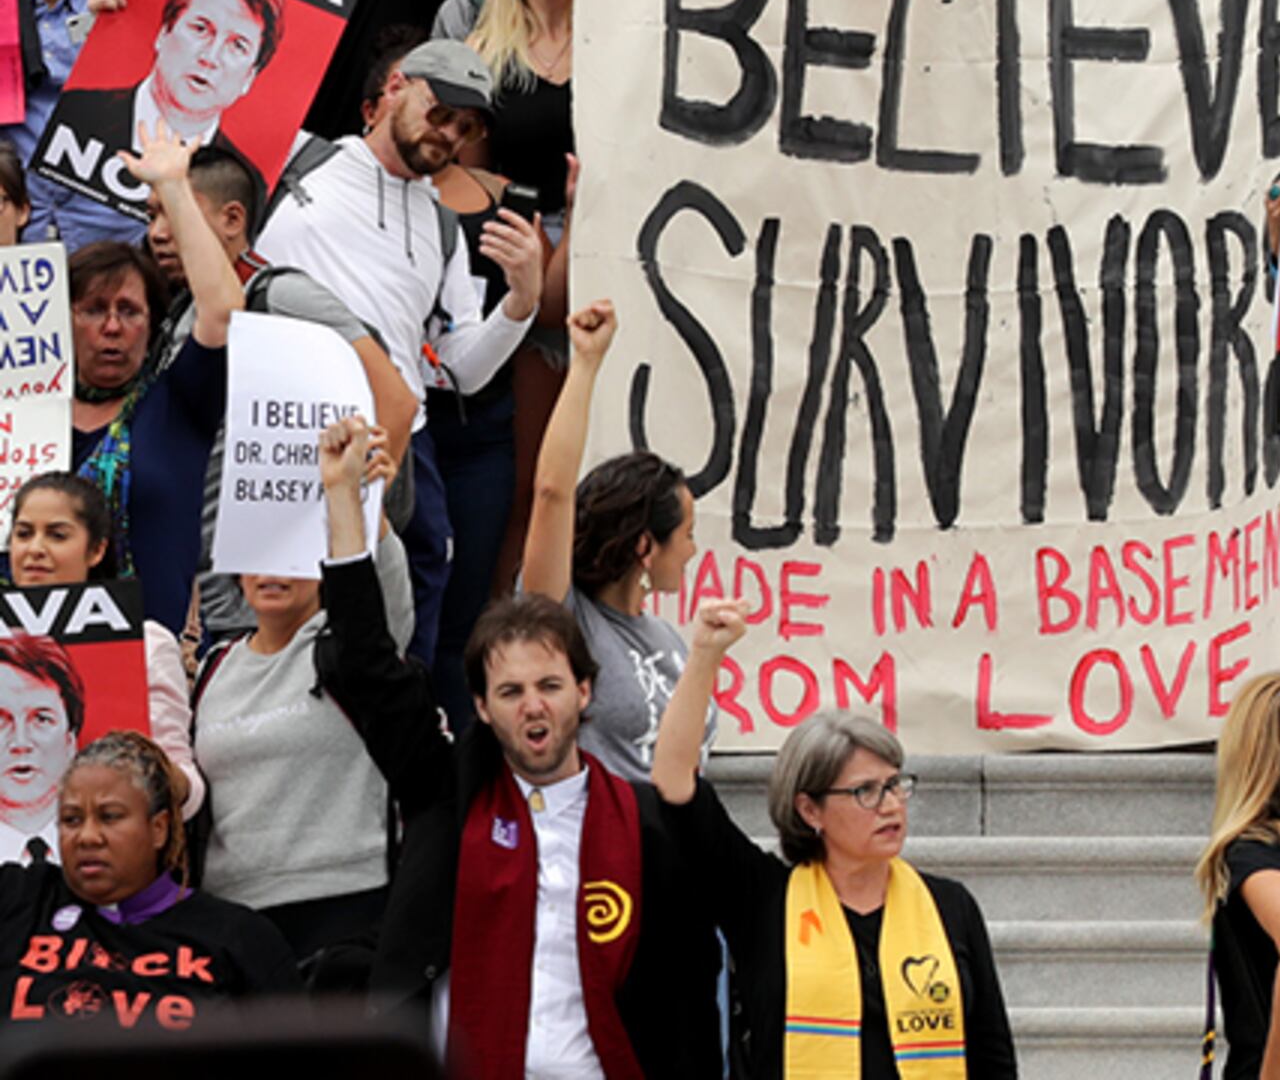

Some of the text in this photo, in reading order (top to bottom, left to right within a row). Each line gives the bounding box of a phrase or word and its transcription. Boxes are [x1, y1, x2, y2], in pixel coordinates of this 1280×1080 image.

[252, 400, 260, 426] I
[234, 440, 268, 465] DR.
[235, 479, 313, 502] BLASEY
[872, 554, 932, 636] IN
[951, 551, 998, 629] A
[710, 622, 1253, 736] ROM LOVE
[896, 1013, 956, 1034] LOVE
